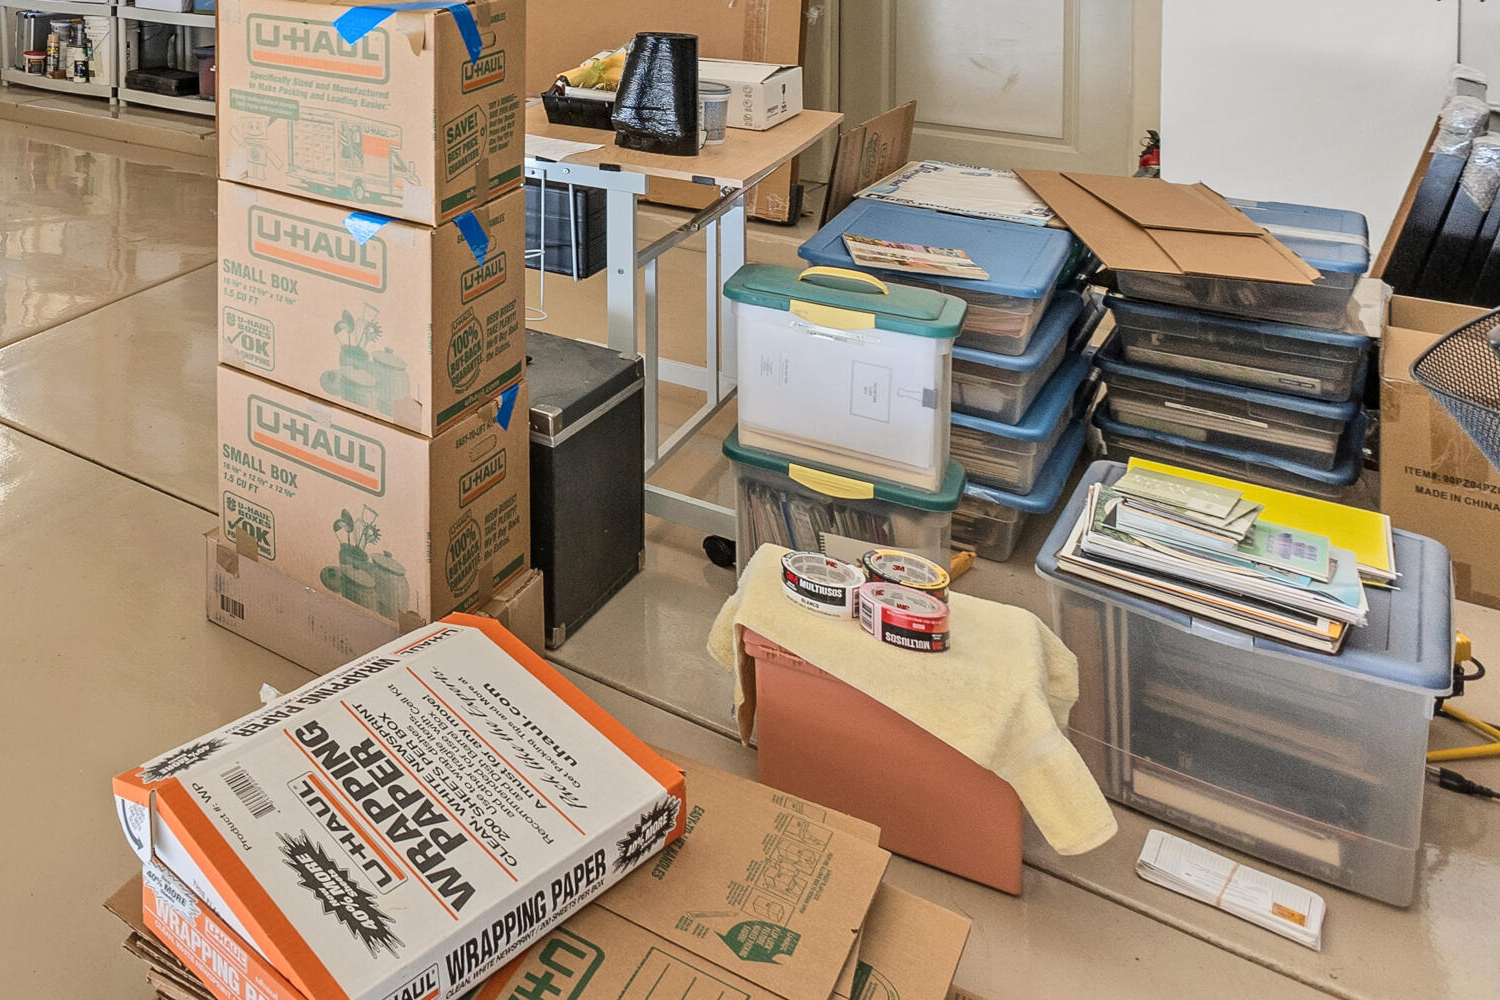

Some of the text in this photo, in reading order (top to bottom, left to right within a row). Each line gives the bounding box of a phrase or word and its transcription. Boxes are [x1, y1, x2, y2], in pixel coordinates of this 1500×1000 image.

[256, 23, 380, 61] U-HAUL
[465, 56, 503, 80] U-HAUL
[250, 71, 389, 99] Specifically Sized and Manufactured
[258, 83, 277, 92] Make
[279, 87, 308, 99] Packing
[310, 92, 325, 101] and
[327, 94, 358, 107] Loading
[447, 112, 478, 144] SAVE!
[448, 146, 461, 164] BEST
[257, 215, 377, 270] U-HAUL
[223, 258, 299, 296] SMALL BOX
[464, 259, 504, 291] U-HAUL
[223, 287, 258, 305] 1.5 CU FT
[237, 316, 271, 332] U-HAUL
[238, 323, 271, 340] BOXES
[451, 324, 479, 357] 100%
[241, 334, 270, 357] OK
[451, 341, 482, 376] BUY-BACK
[256, 405, 375, 473] U-HAUL
[222, 443, 299, 489] SMALL BOX
[462, 456, 504, 494] U-HAUL
[1404, 466, 1500, 494] ITEM#: 90PZ04PZ
[223, 472, 259, 494] 1.5 CU FT
[1415, 485, 1500, 512] MADE IN CHINA
[237, 502, 272, 521] U-HAUL
[238, 510, 271, 530] BOXES
[241, 521, 270, 546] OK
[449, 524, 477, 561] 100%
[448, 541, 480, 580] BUY-BACK
[785, 570, 798, 584] 3M
[825, 559, 838, 569] 3M
[893, 564, 905, 573] 3M
[799, 578, 843, 598] MULTIUSOS
[801, 597, 819, 609] BLANCO
[399, 629, 460, 656] U-HAUL
[885, 631, 930, 650] MULTIUSOS
[301, 657, 400, 706] WRAPPING
[231, 705, 302, 737] PAPER
[457, 676, 581, 788] Get Packing Tips and More at
[483, 682, 577, 767] uhaul.com
[485, 721, 514, 741] the
[351, 703, 425, 773] NEWSPRINT
[421, 694, 547, 809] A must for any move!
[387, 683, 554, 845] Recommended for use with Cell Kit
[406, 724, 497, 815] Use to wrap dishes
[408, 713, 515, 818] and other fragile items.
[427, 711, 523, 801] and Dish Barrel Box
[511, 746, 545, 770] like
[191, 782, 212, 803] WP
[378, 711, 510, 841] 200 SHEETS PER BOX
[540, 775, 588, 809] Pack
[349, 737, 468, 855] PAPER
[422, 773, 466, 816] WHITE
[220, 812, 253, 851] Product
[286, 719, 476, 912] WRAPPING
[646, 812, 668, 840] MORE
[292, 779, 392, 888] U-HAUL
[468, 815, 517, 867] CLEAN,
[651, 845, 678, 880] HANDLES
[164, 882, 187, 906] MORE
[292, 848, 382, 932] 40% MORE
[315, 885, 341, 908] Now
[324, 867, 359, 898] Sheets
[445, 849, 606, 986] WRAPPING PAPER
[155, 899, 240, 994] WRAPPING
[446, 976, 471, 999] CLEAN,
[473, 960, 495, 978] WHITE
[496, 927, 536, 963] NEWSPRINT
[552, 901, 577, 923] SHEETS
[577, 890, 591, 904] PER
[592, 878, 605, 893] BOX
